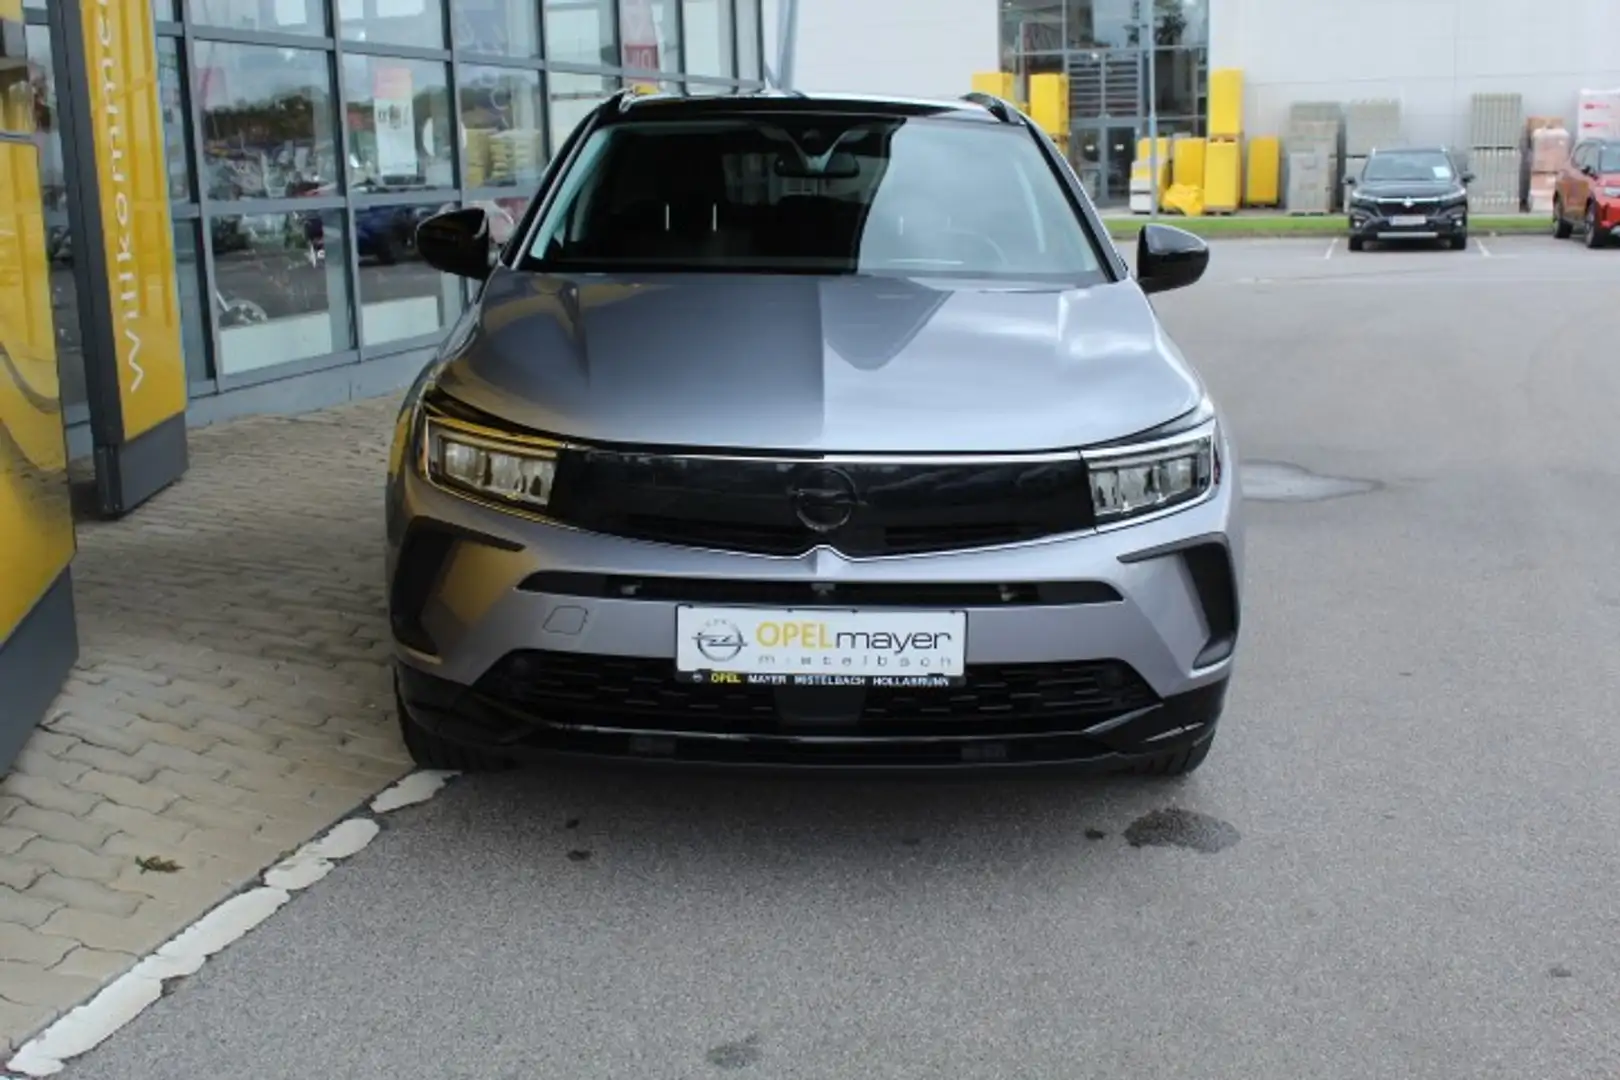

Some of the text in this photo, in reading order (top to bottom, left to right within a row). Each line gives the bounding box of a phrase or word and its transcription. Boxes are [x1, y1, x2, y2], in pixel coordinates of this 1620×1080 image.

[97, 0, 145, 393] Willkomme
[711, 673, 742, 684] OPEL
[747, 674, 787, 685] MAYER
